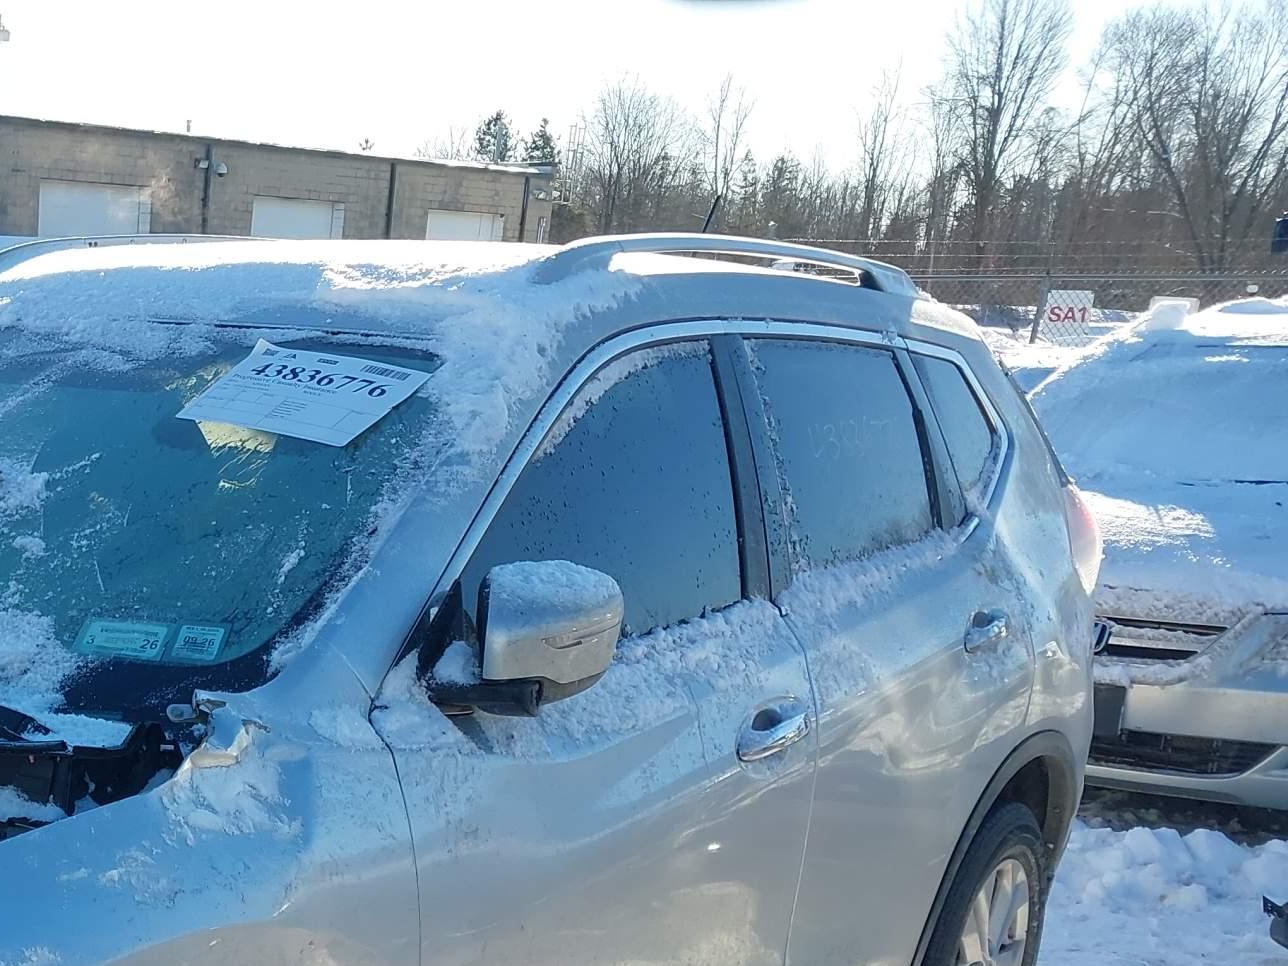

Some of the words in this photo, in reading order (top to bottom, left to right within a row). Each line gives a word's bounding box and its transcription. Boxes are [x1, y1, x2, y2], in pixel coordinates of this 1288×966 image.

[1048, 306, 1087, 323] SA1
[250, 362, 395, 398] 43836776
[86, 634, 96, 645] 3
[139, 639, 160, 650] 26
